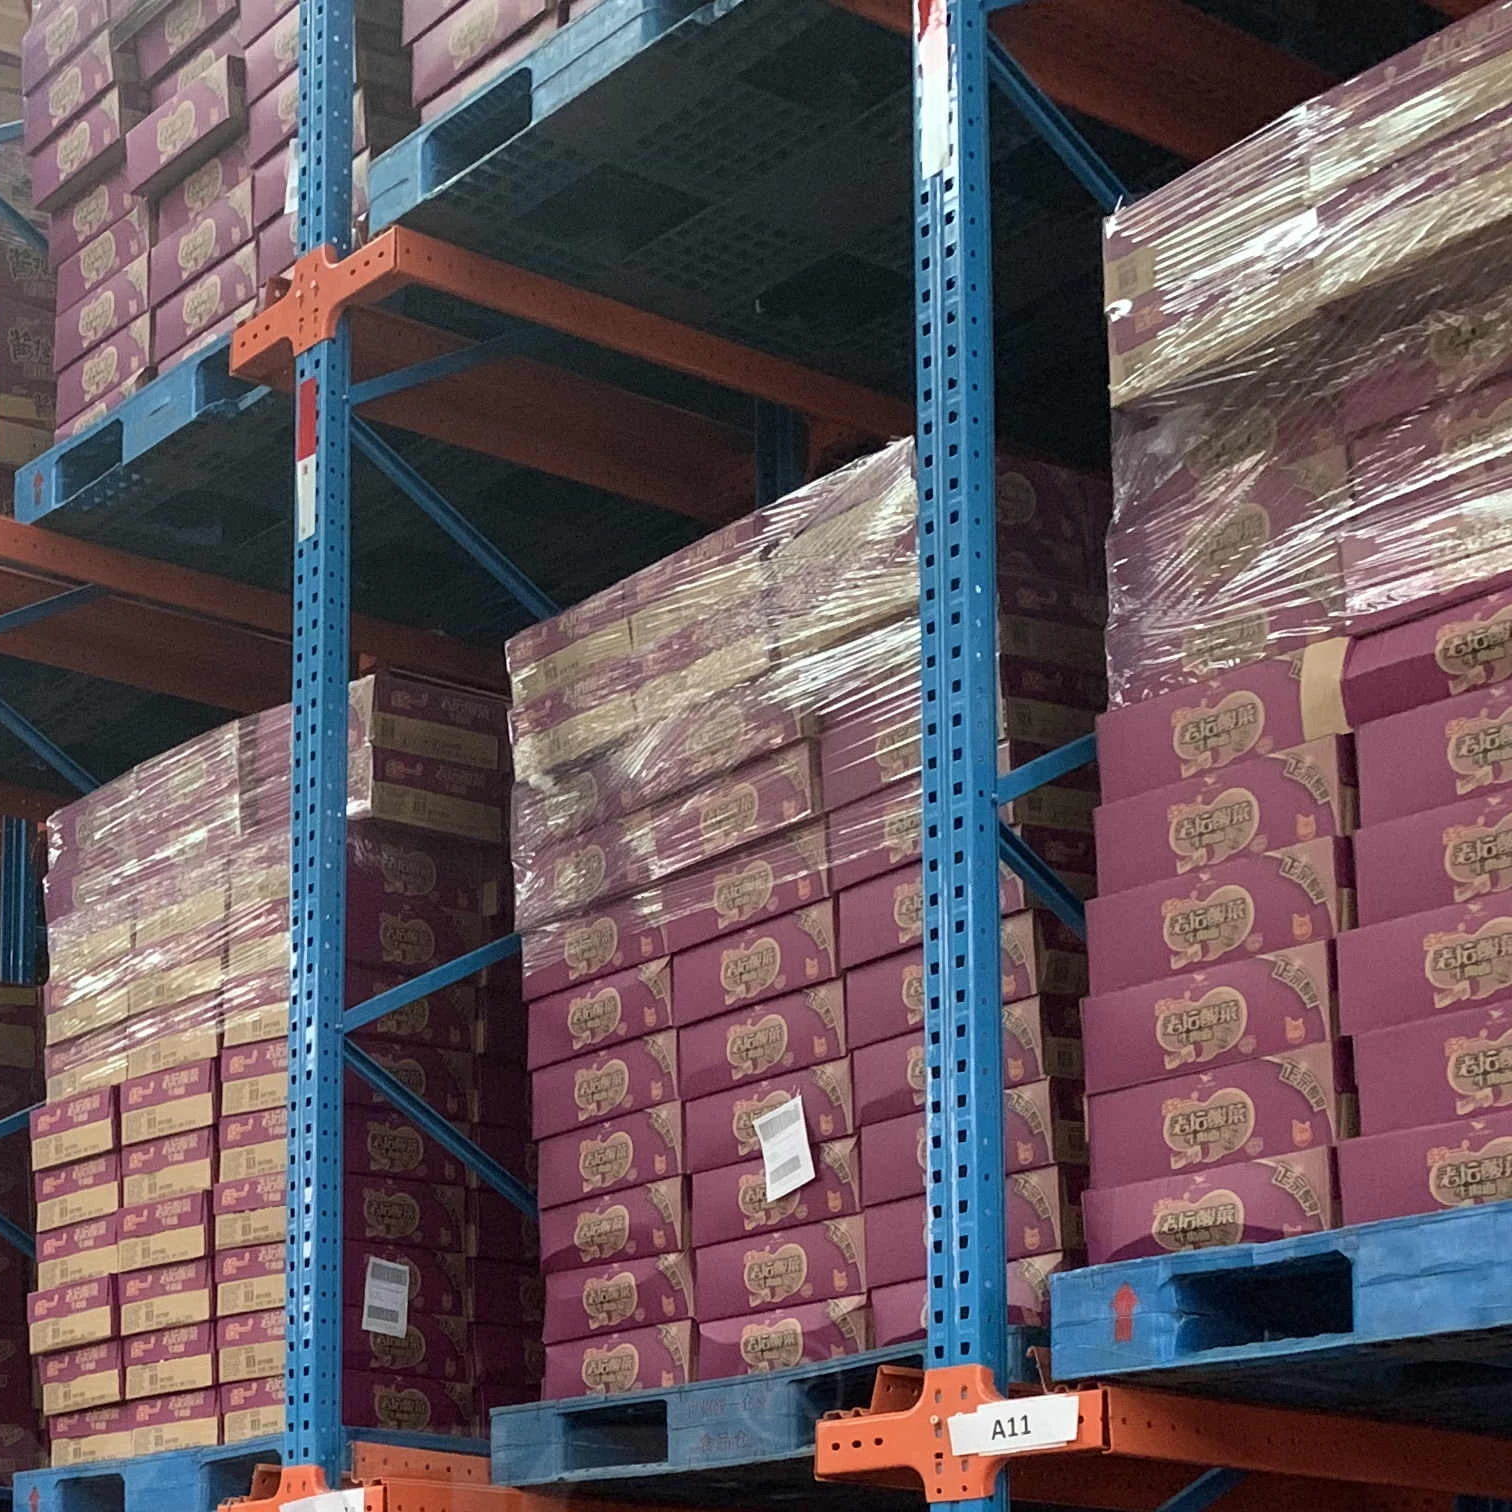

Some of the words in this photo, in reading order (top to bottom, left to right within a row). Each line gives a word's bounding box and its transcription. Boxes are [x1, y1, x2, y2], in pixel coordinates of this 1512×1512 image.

[1436, 935, 1512, 971] 老坛酸
[1438, 1158, 1512, 1189] 老坛酸
[991, 1414, 1032, 1441] A11
